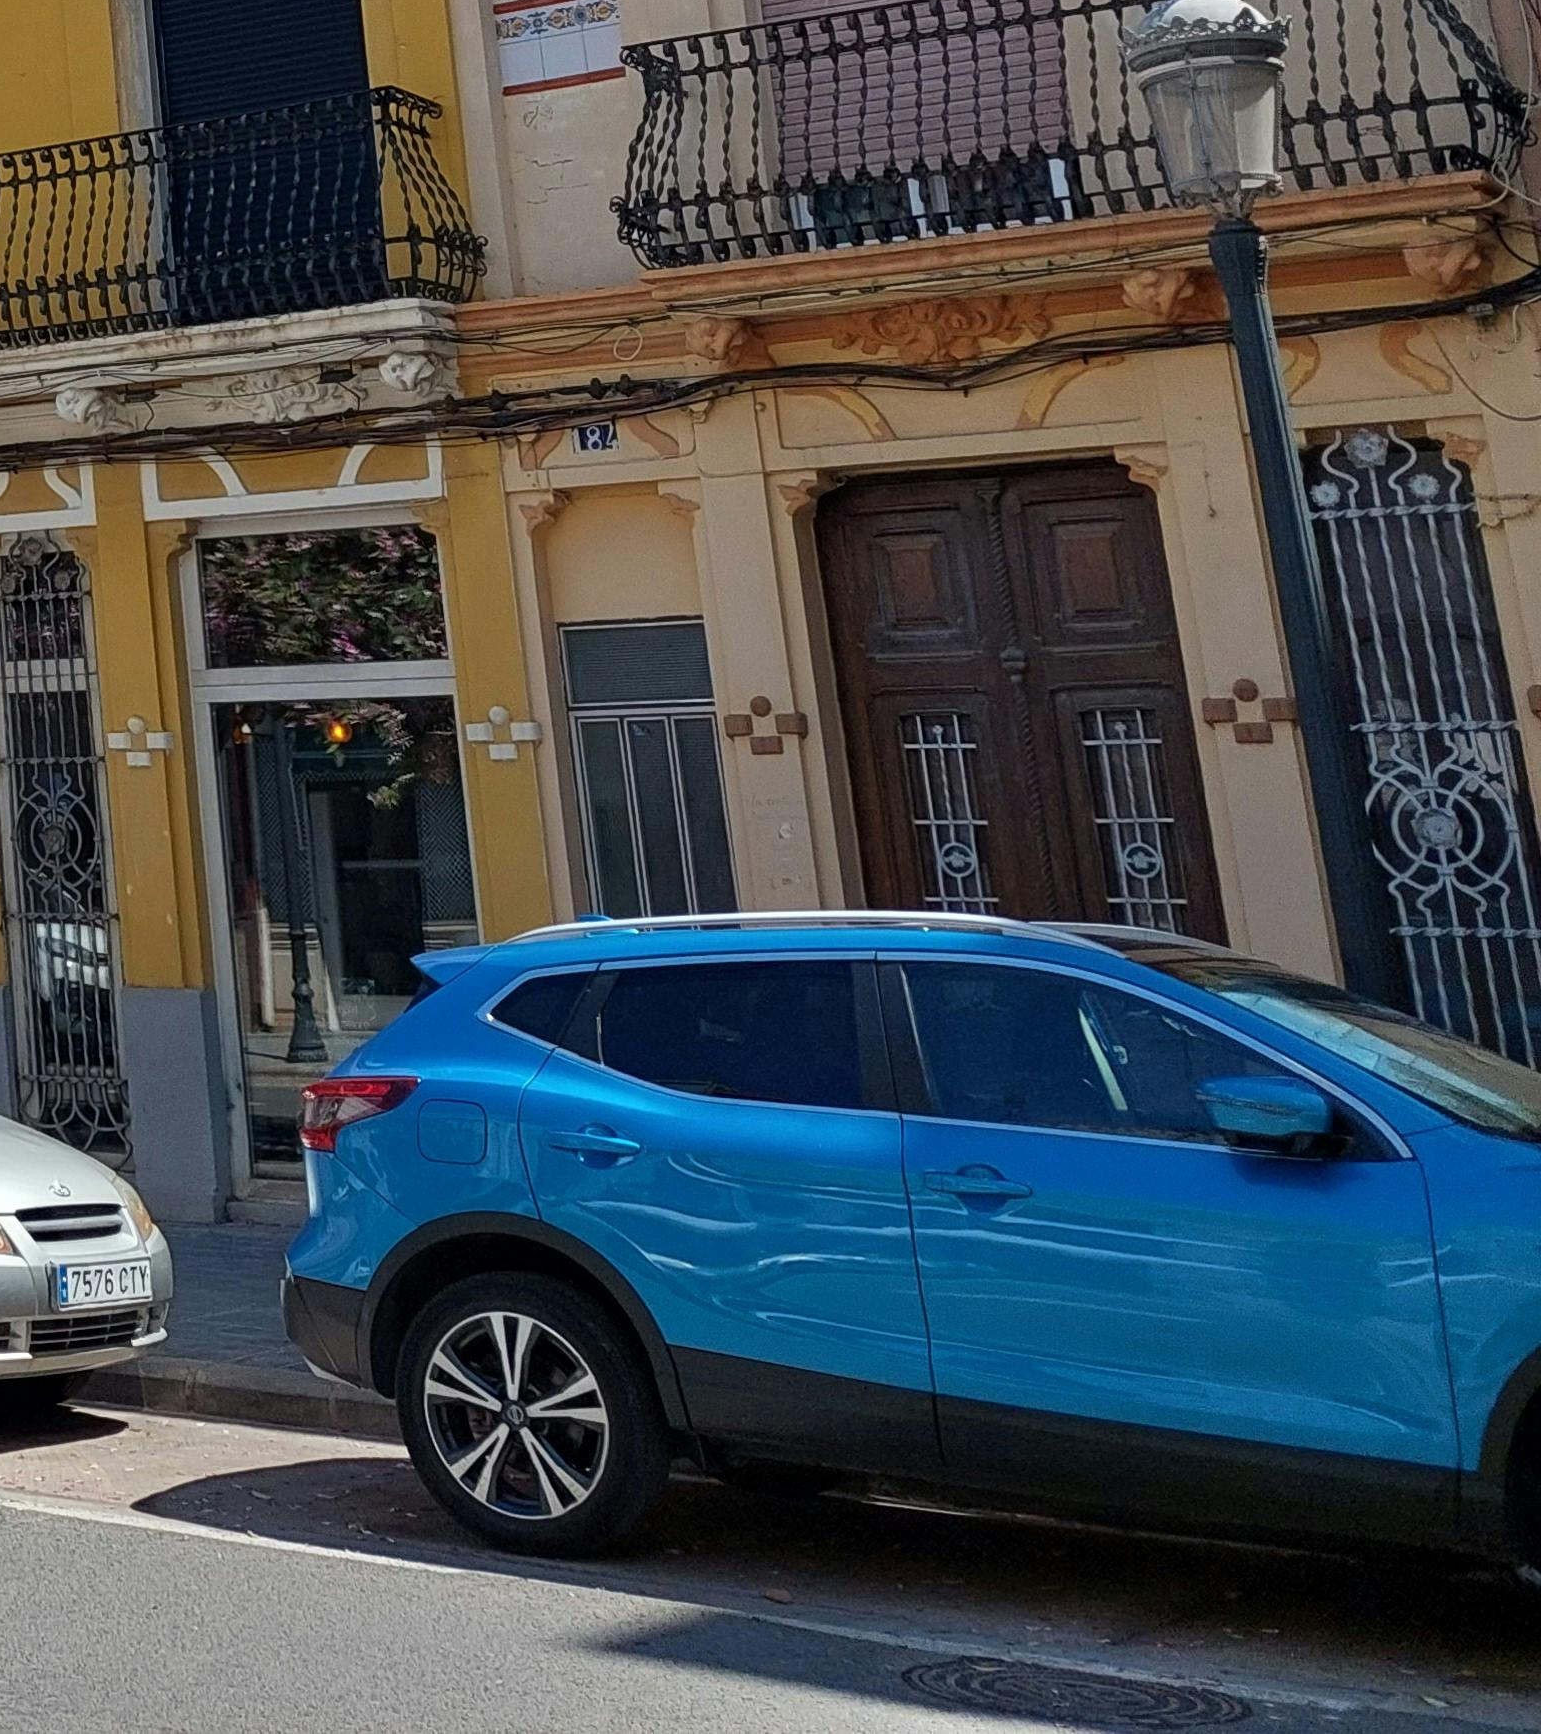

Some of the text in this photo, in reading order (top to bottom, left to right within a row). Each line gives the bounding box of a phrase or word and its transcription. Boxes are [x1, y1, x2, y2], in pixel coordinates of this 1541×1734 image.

[572, 422, 620, 454] 184
[71, 1265, 147, 1299] 7576 CTY
